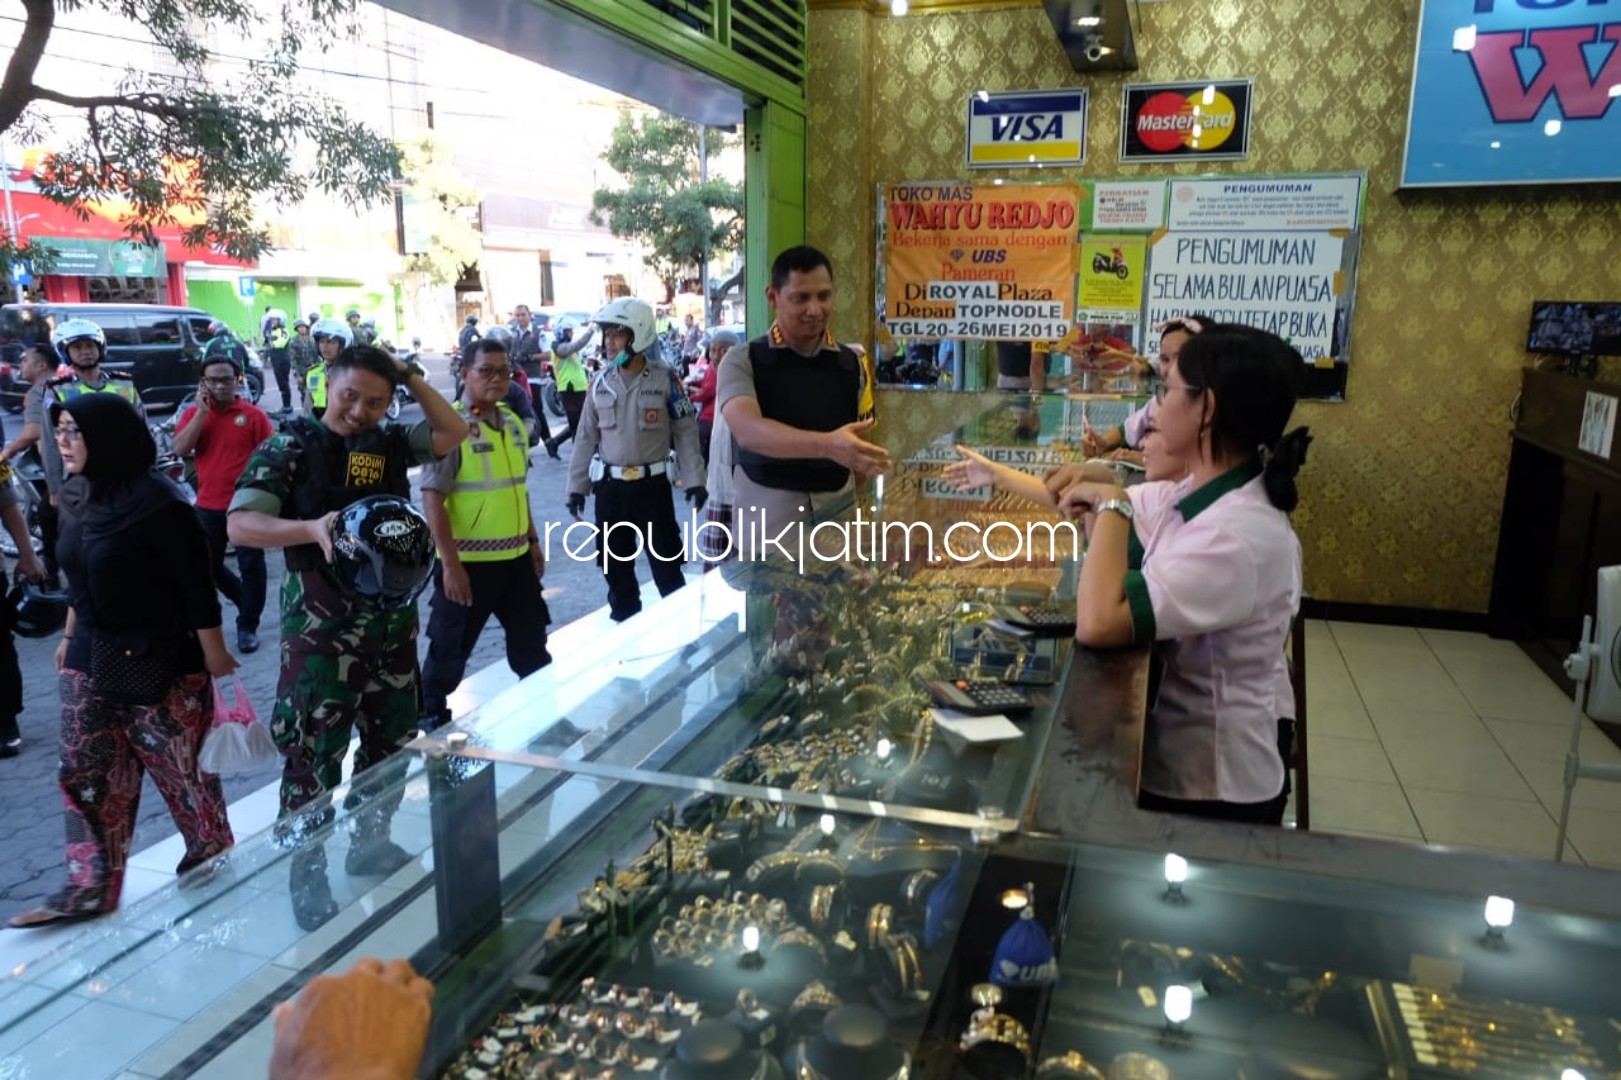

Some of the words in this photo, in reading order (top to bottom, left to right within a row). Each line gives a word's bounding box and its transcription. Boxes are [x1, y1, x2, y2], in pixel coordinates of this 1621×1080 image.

[992, 114, 1064, 141] VISA
[1137, 112, 1234, 132] MasterCard
[891, 187, 933, 201] TOKO
[938, 186, 973, 200] MAS
[1223, 184, 1312, 193] PENGUMUMAN
[890, 202, 983, 230] WAHYU
[987, 200, 1075, 230] REDJO
[892, 232, 950, 249] Bekerja
[957, 234, 999, 246] sama
[1005, 231, 1068, 249] dengan
[972, 249, 1007, 263] UBS
[1176, 237, 1316, 265] PENGUMUMAN
[942, 262, 1016, 282] Pameran
[905, 283, 927, 301] Di
[929, 284, 997, 299] ROYAL
[998, 283, 1053, 301] Plaza
[1153, 273, 1215, 300] SELAMA
[1218, 274, 1275, 301] BULAN
[1275, 274, 1332, 302] PUASA
[896, 302, 956, 318] Depan
[958, 304, 1061, 319] TOPNODLE
[888, 321, 924, 336] TGL
[982, 324, 1016, 337] MEI
[1019, 323, 1067, 338] 2019
[1289, 310, 1328, 339] BUKA
[351, 455, 382, 469] KODIM
